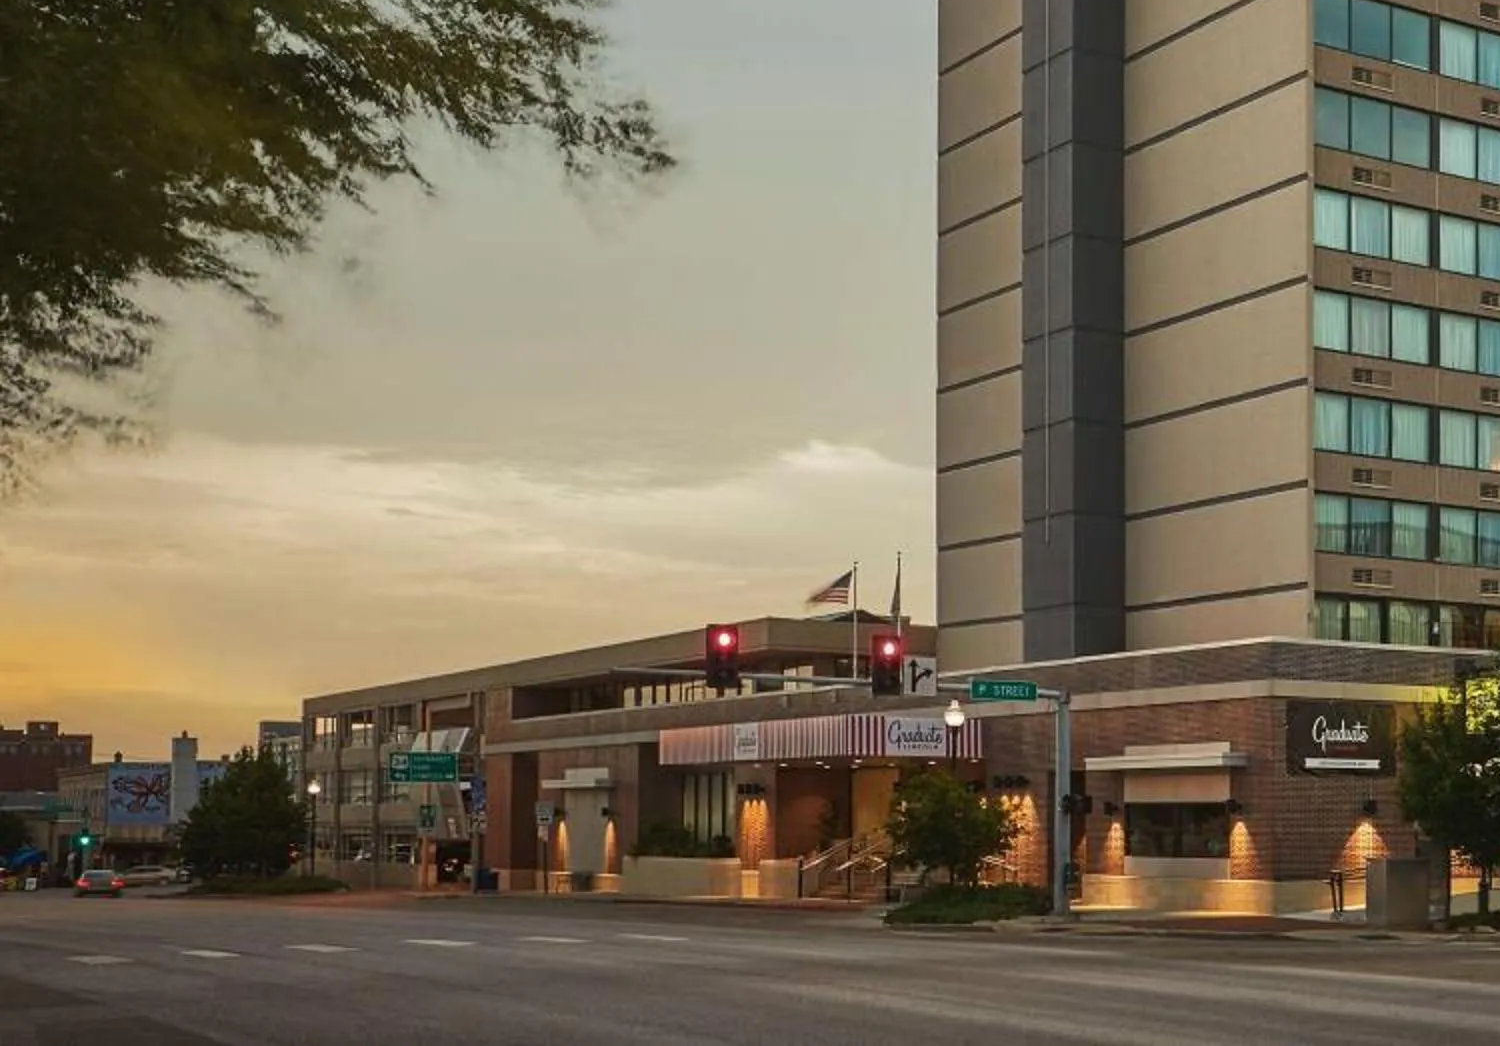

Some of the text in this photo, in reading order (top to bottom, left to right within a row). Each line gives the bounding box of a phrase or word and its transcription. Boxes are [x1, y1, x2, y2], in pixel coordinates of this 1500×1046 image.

[978, 684, 1031, 698] P STREET
[887, 719, 945, 749] Graduate
[1312, 715, 1369, 754] Graduate
